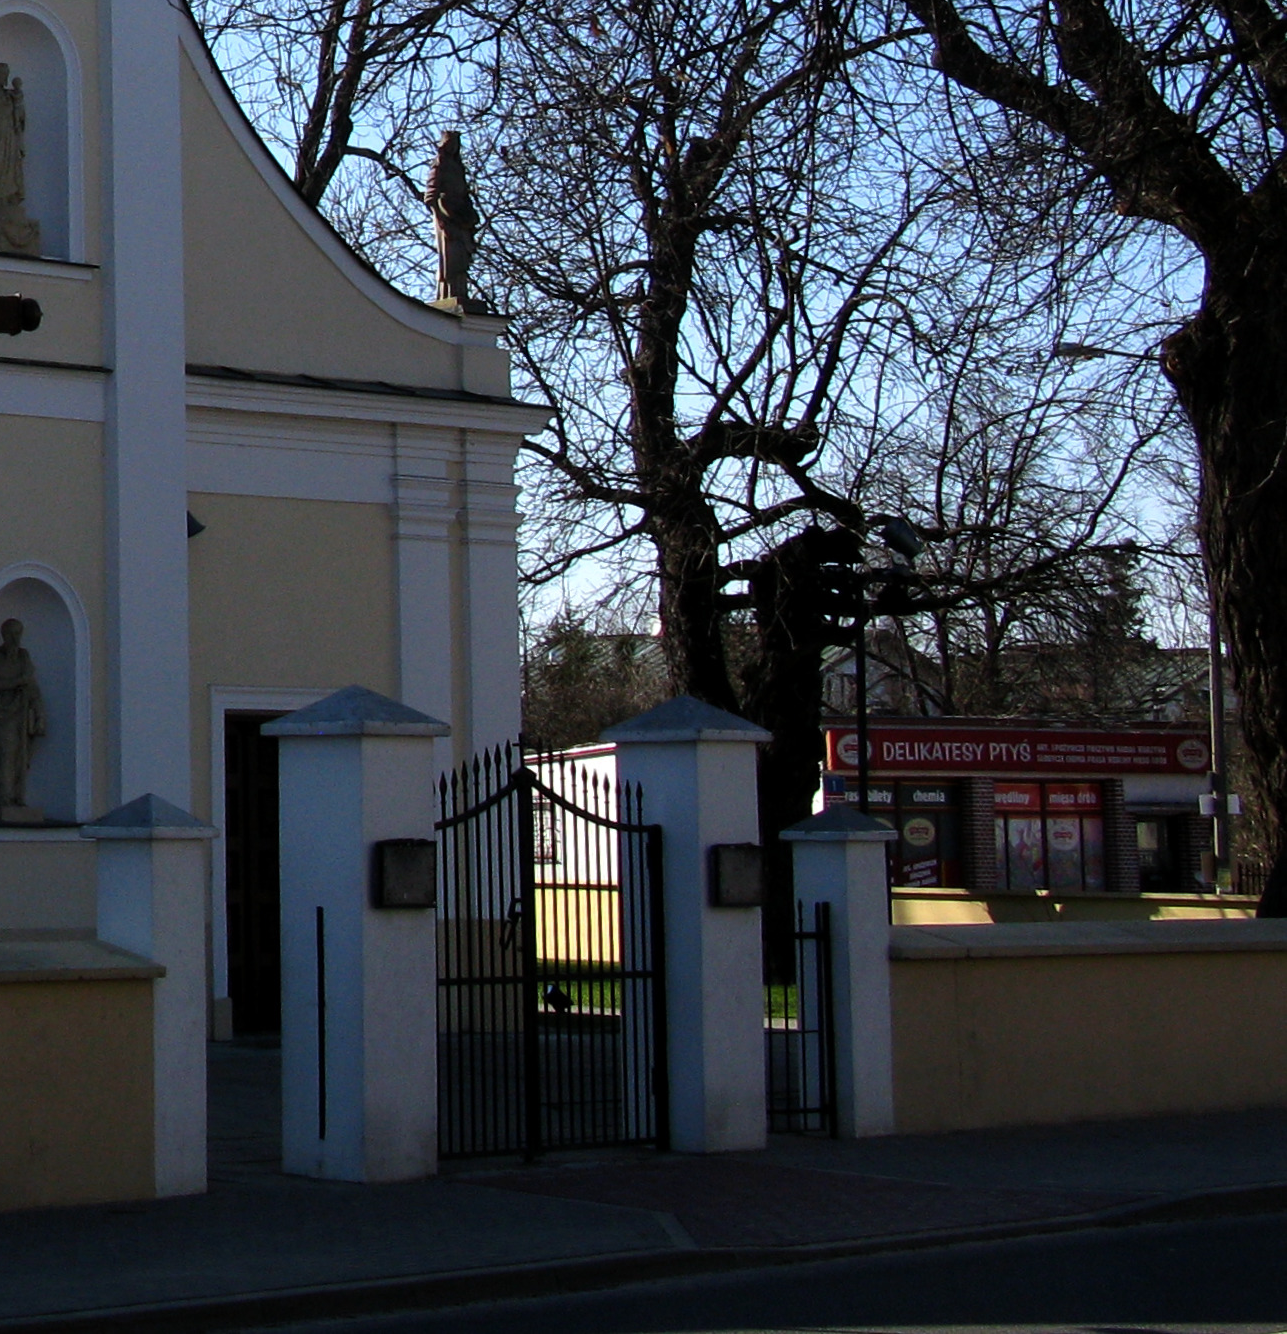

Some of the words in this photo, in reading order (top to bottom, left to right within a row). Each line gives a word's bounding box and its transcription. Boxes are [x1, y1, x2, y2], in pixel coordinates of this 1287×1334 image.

[882, 741, 984, 761] DELIKATESY
[989, 738, 1031, 762] PTYŚ
[912, 789, 946, 803] chemia
